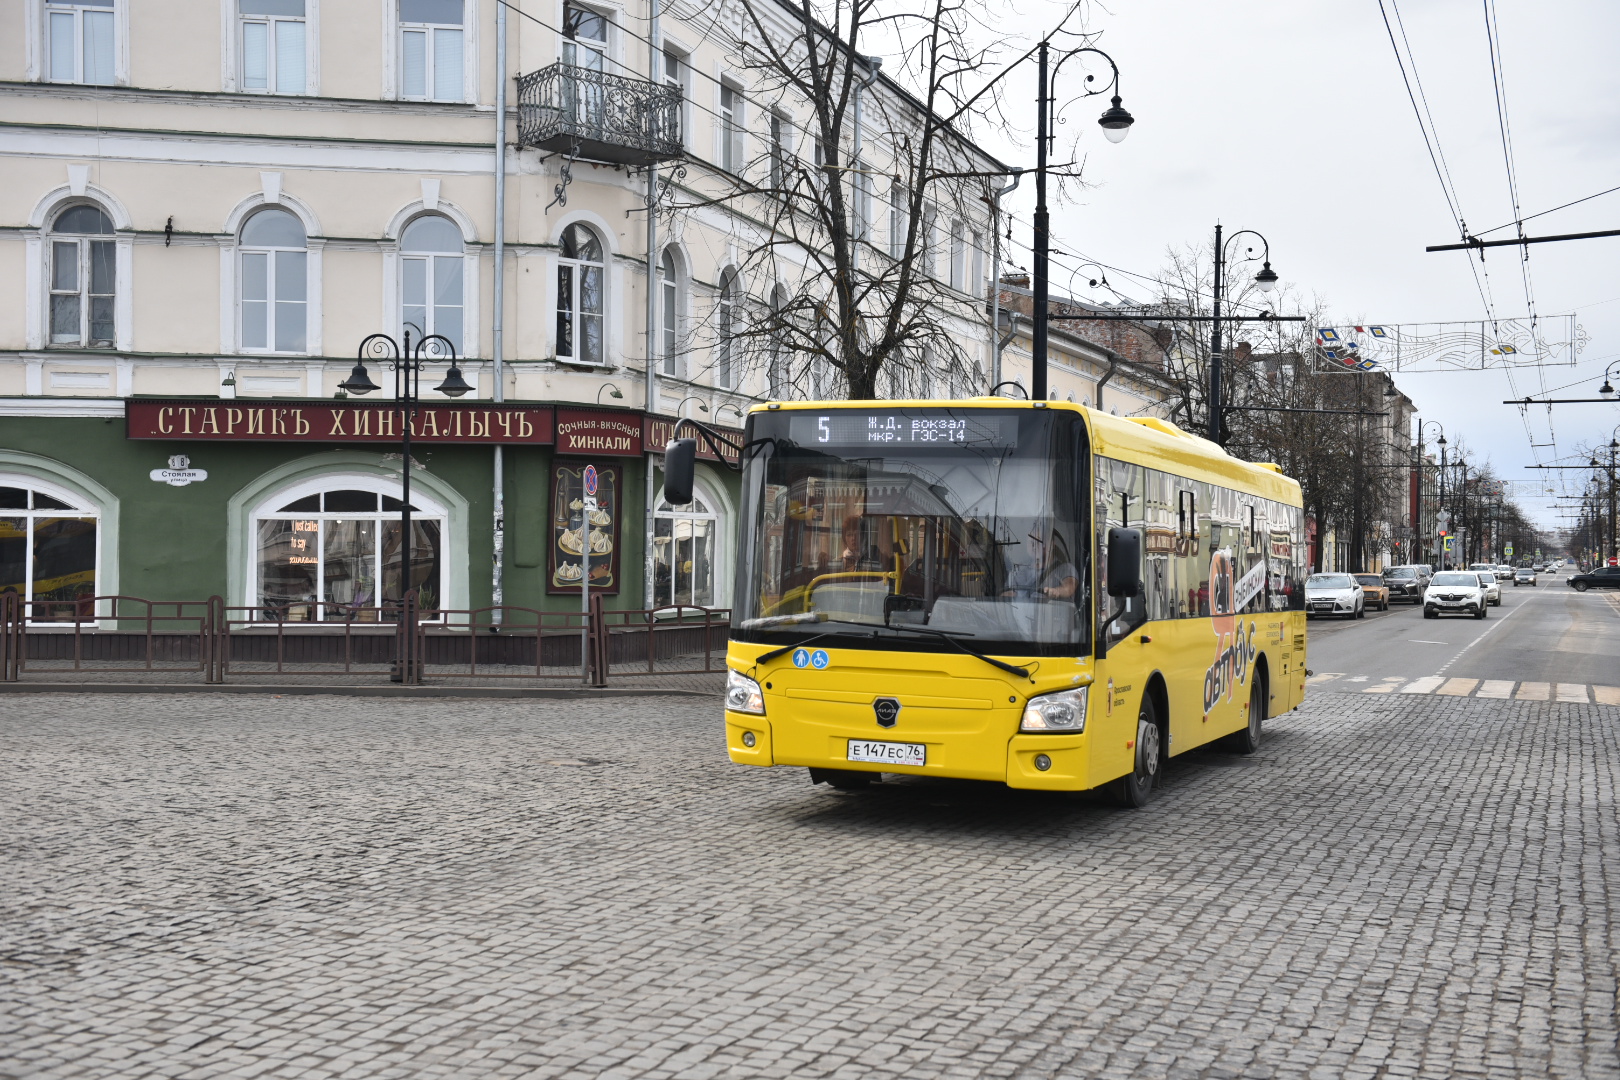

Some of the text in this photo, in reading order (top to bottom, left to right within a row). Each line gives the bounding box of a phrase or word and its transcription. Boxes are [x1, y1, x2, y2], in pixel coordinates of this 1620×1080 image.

[818, 416, 830, 443] 5
[868, 416, 966, 430] Ж.Д. вокзал
[568, 434, 631, 451] ХИНКАЛИ
[868, 429, 966, 443] мкр. ГЭС-14
[161, 470, 197, 478] Стоялая
[291, 536, 306, 552] to say
[907, 745, 920, 756] 76
